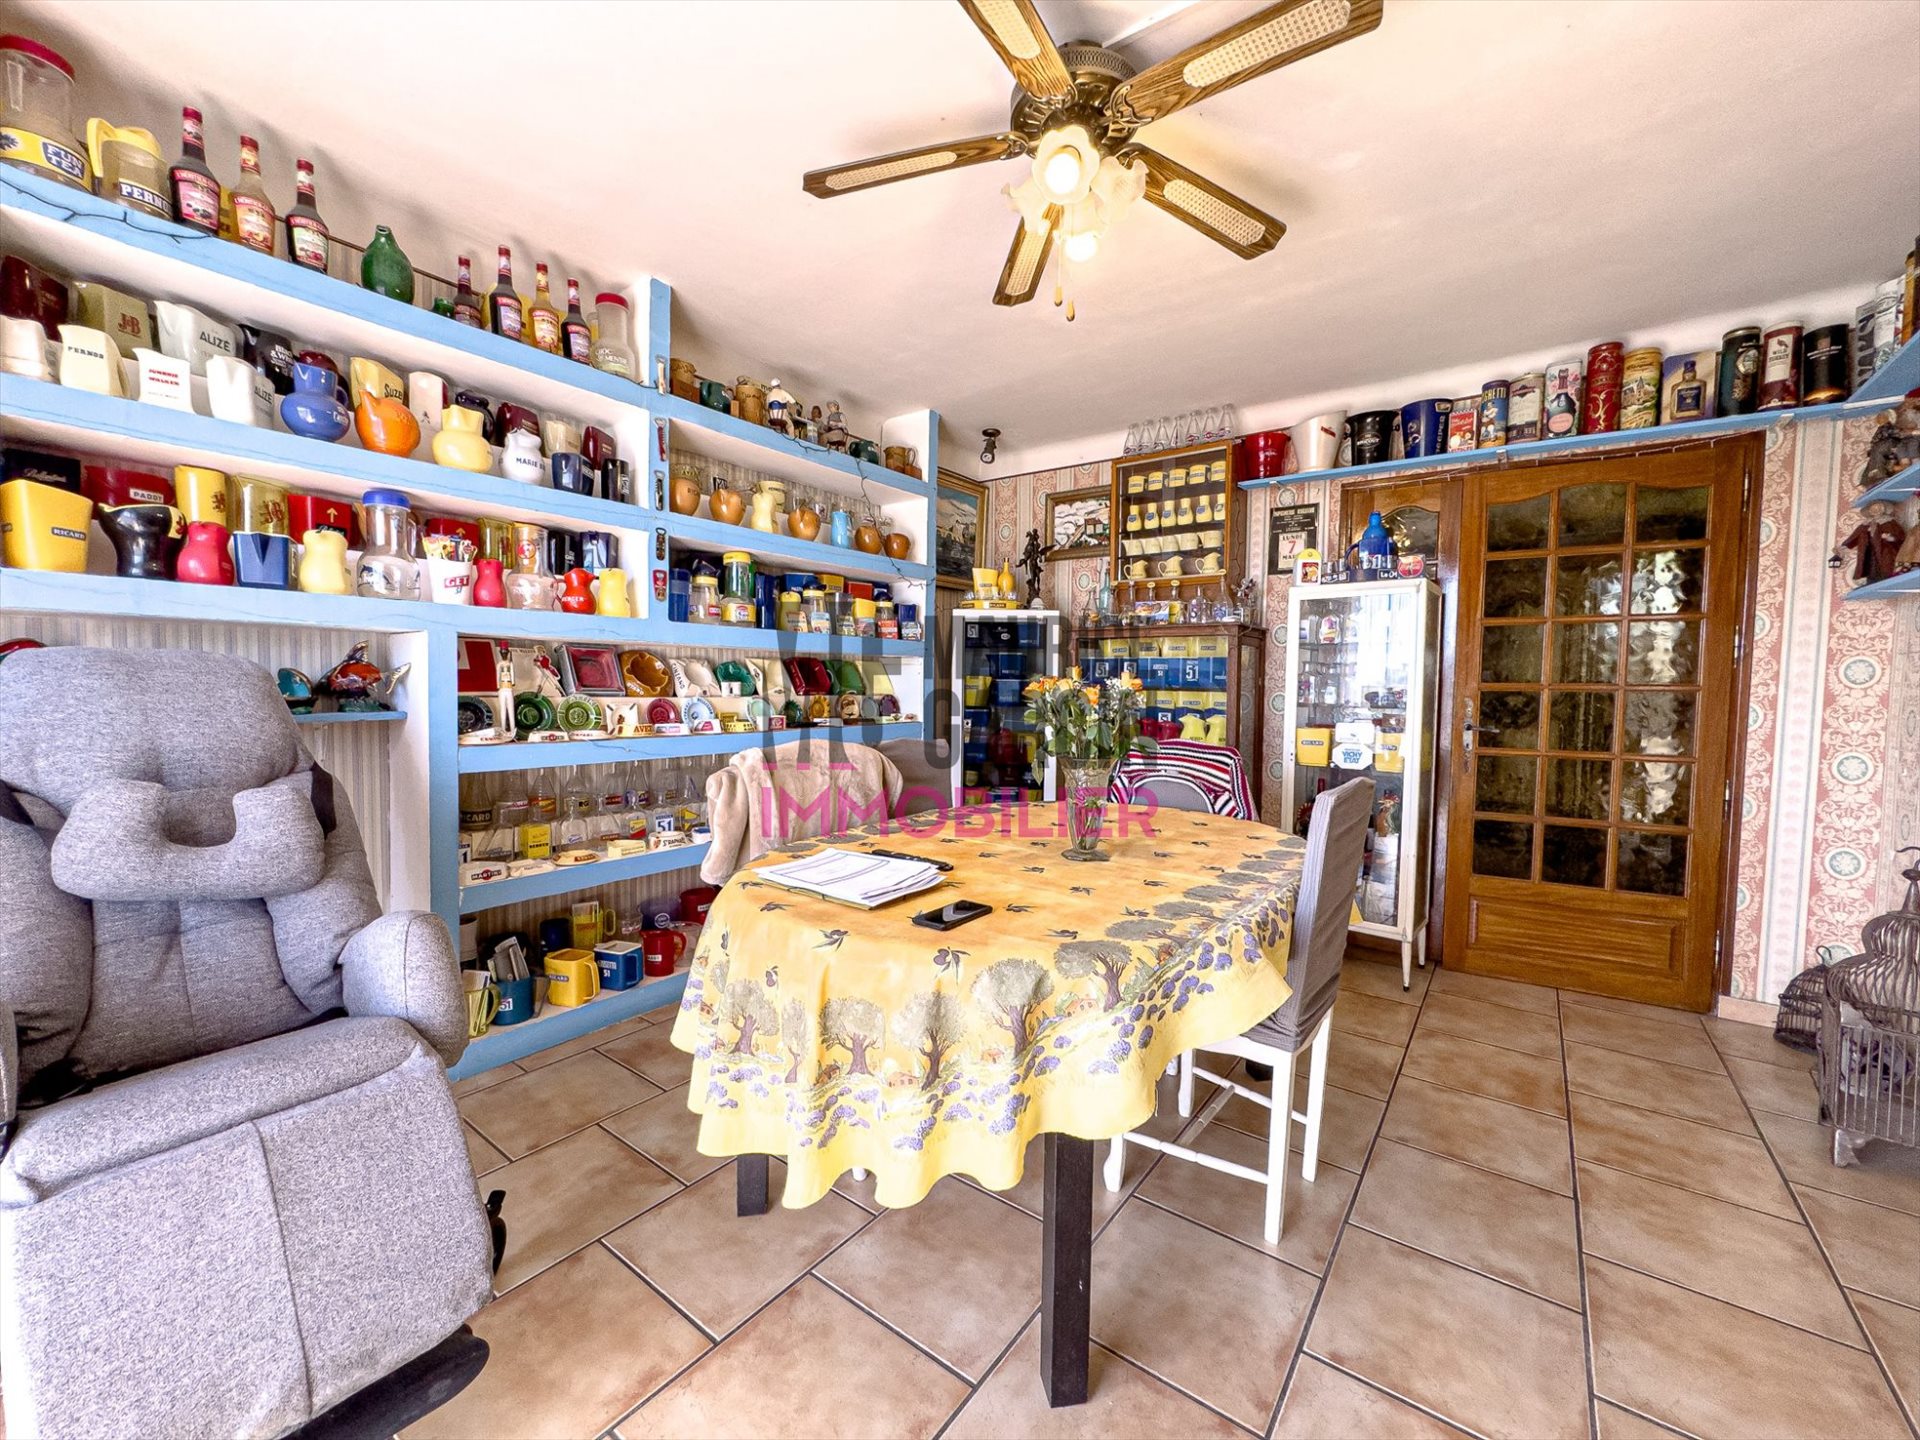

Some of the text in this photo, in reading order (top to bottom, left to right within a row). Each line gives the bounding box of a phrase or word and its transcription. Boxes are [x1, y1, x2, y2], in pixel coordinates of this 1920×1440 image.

[46, 142, 84, 172] FUN
[50, 155, 84, 179] TEA
[516, 457, 538, 468] MARIE
[133, 491, 163, 502] PADDY
[53, 528, 85, 539] RICARD
[1288, 540, 1297, 554] 7
[445, 576, 468, 588] GET
[1185, 665, 1198, 680] 51
[461, 811, 491, 822] ICARD
[656, 820, 673, 832] 51
[470, 868, 502, 880] MARTINI
[500, 999, 512, 1010] 51
